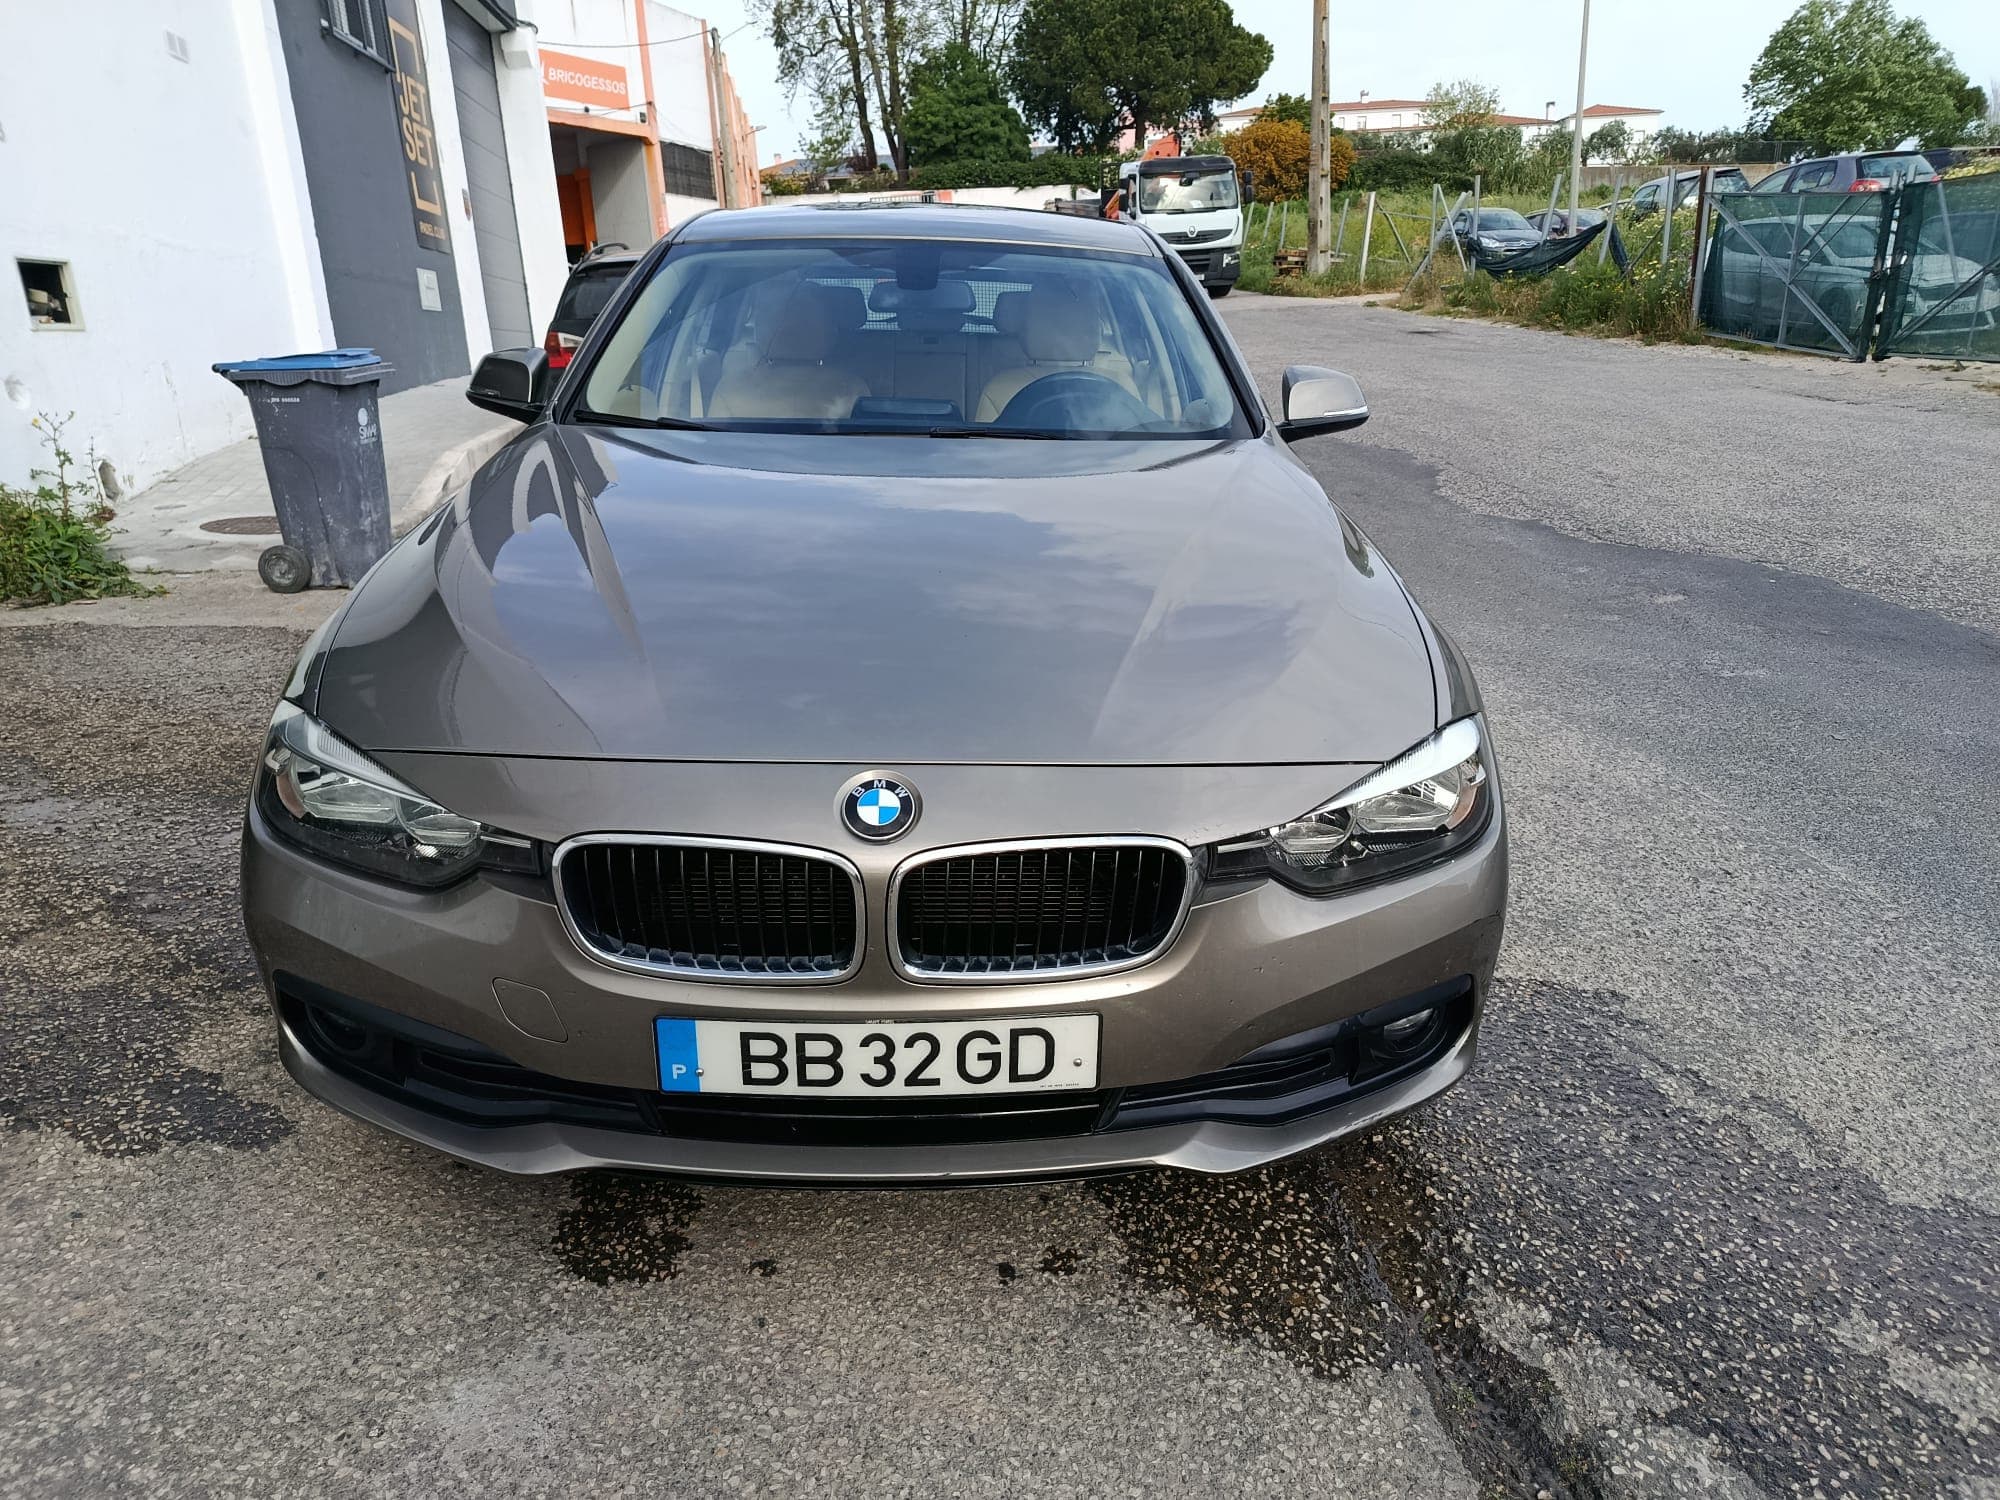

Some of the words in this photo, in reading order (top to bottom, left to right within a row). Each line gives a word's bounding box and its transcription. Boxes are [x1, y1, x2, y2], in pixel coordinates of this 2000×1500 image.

[400, 72, 427, 126] JET
[548, 67, 626, 95] BRICOGESSOS
[403, 116, 433, 169] SET
[852, 780, 909, 798] BMW
[672, 1064, 687, 1080] P
[740, 1031, 844, 1087] BB
[859, 1032, 941, 1087] 32
[956, 1027, 1055, 1085] GD
